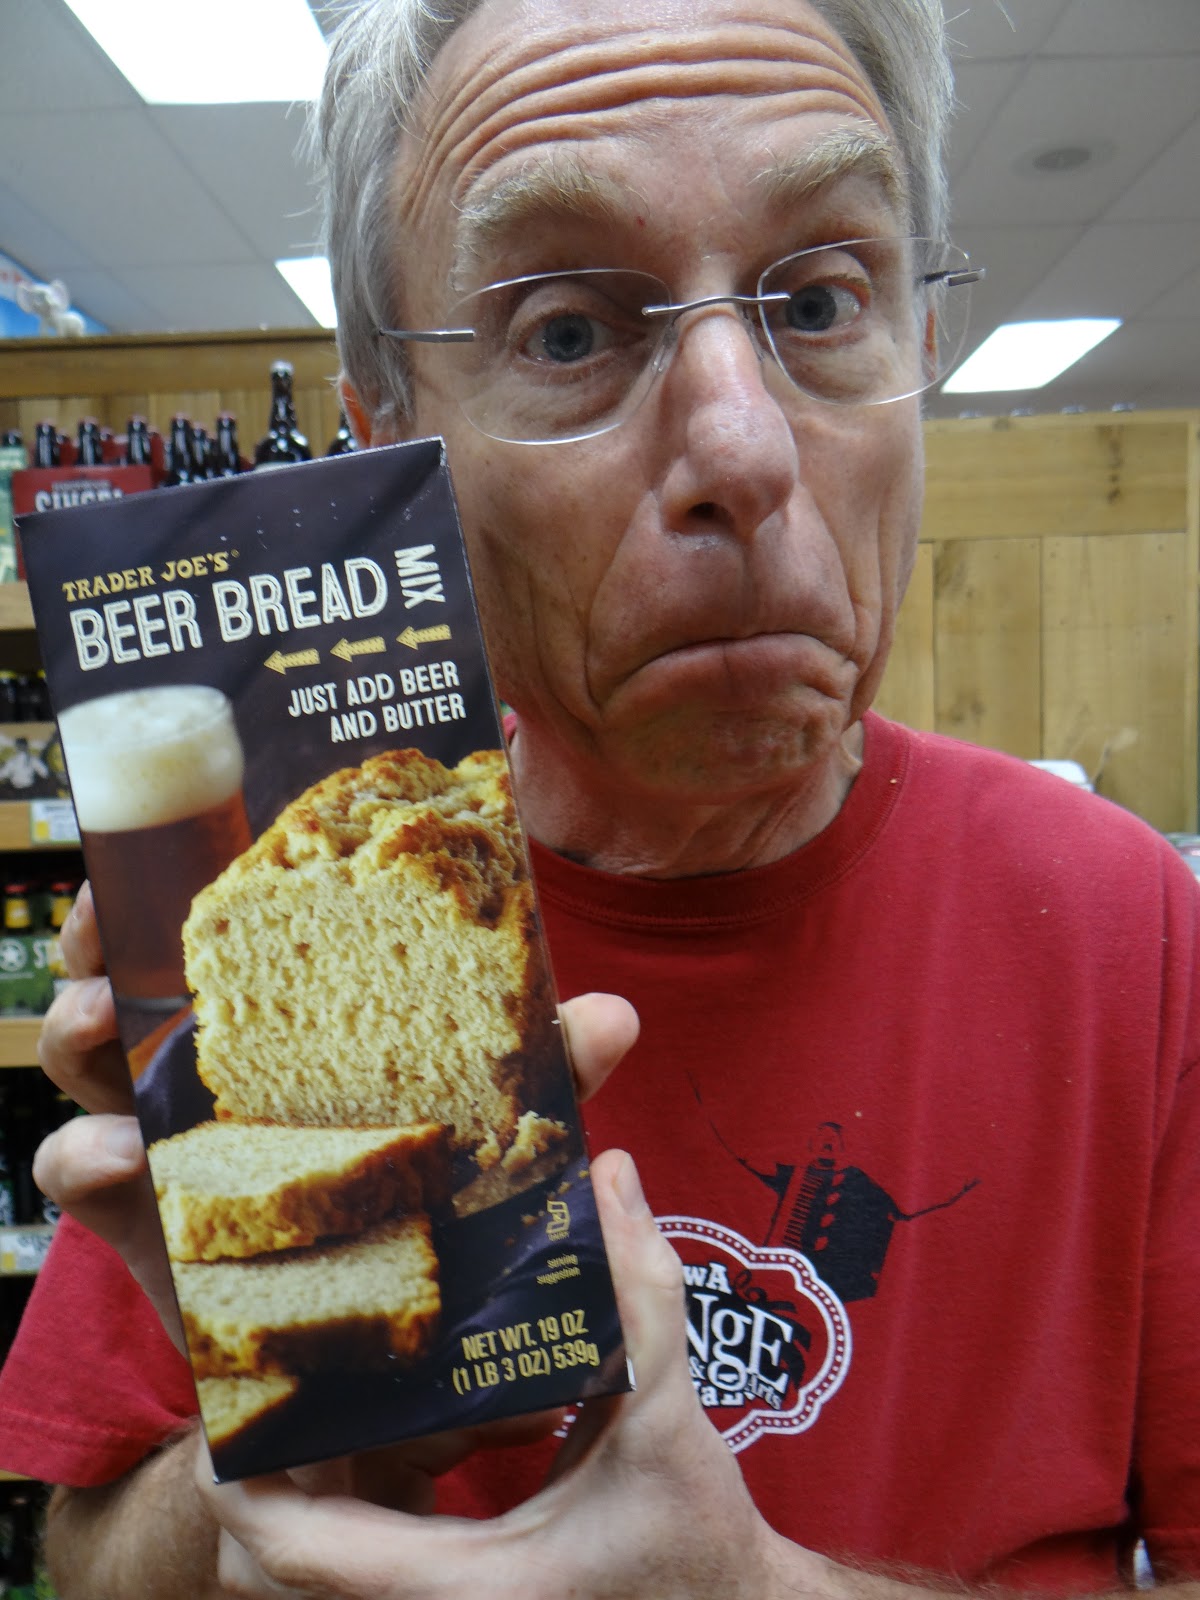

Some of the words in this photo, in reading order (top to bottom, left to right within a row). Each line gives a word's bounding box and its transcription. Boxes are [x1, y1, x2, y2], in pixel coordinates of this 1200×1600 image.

[62, 565, 157, 602] TRADER
[69, 589, 203, 672] BEER
[212, 556, 389, 644] BREAD
[394, 543, 446, 610] MIX
[288, 682, 337, 718] JUST
[346, 673, 395, 707] ADD
[402, 660, 461, 697] BEER
[330, 709, 378, 743] AND
[383, 692, 467, 733] BUTTER
[461, 1330, 498, 1361] NET
[499, 1322, 537, 1352] WT.
[537, 1316, 561, 1343] 19
[561, 1309, 589, 1337] OZ
[452, 1367, 471, 1395] (1
[474, 1361, 500, 1388] LB
[500, 1357, 516, 1382] 3
[518, 1347, 551, 1379] OZ)
[551, 1338, 601, 1370] 539g
